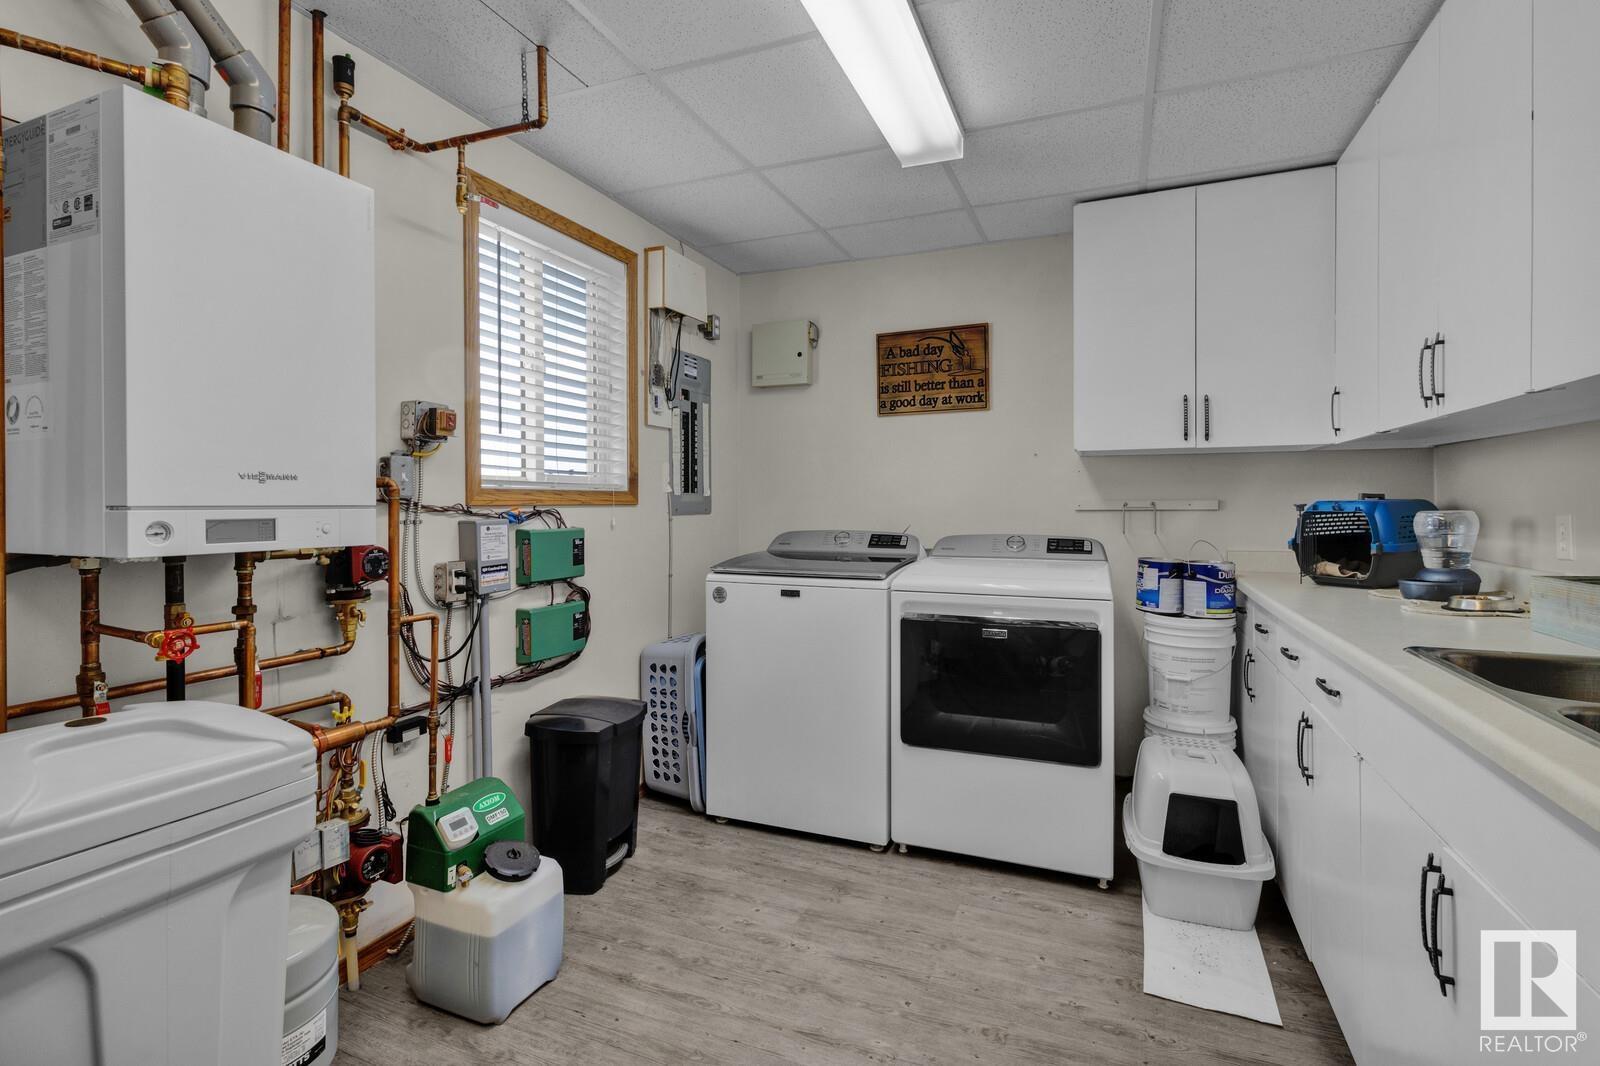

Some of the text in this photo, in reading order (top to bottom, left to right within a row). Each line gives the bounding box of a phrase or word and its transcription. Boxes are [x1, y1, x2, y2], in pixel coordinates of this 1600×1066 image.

[886, 343, 944, 359] A bad day
[881, 358, 953, 377] FISHING
[880, 376, 984, 394] is still better than a
[880, 392, 984, 411] a good day at work
[479, 794, 500, 809] AXIOM
